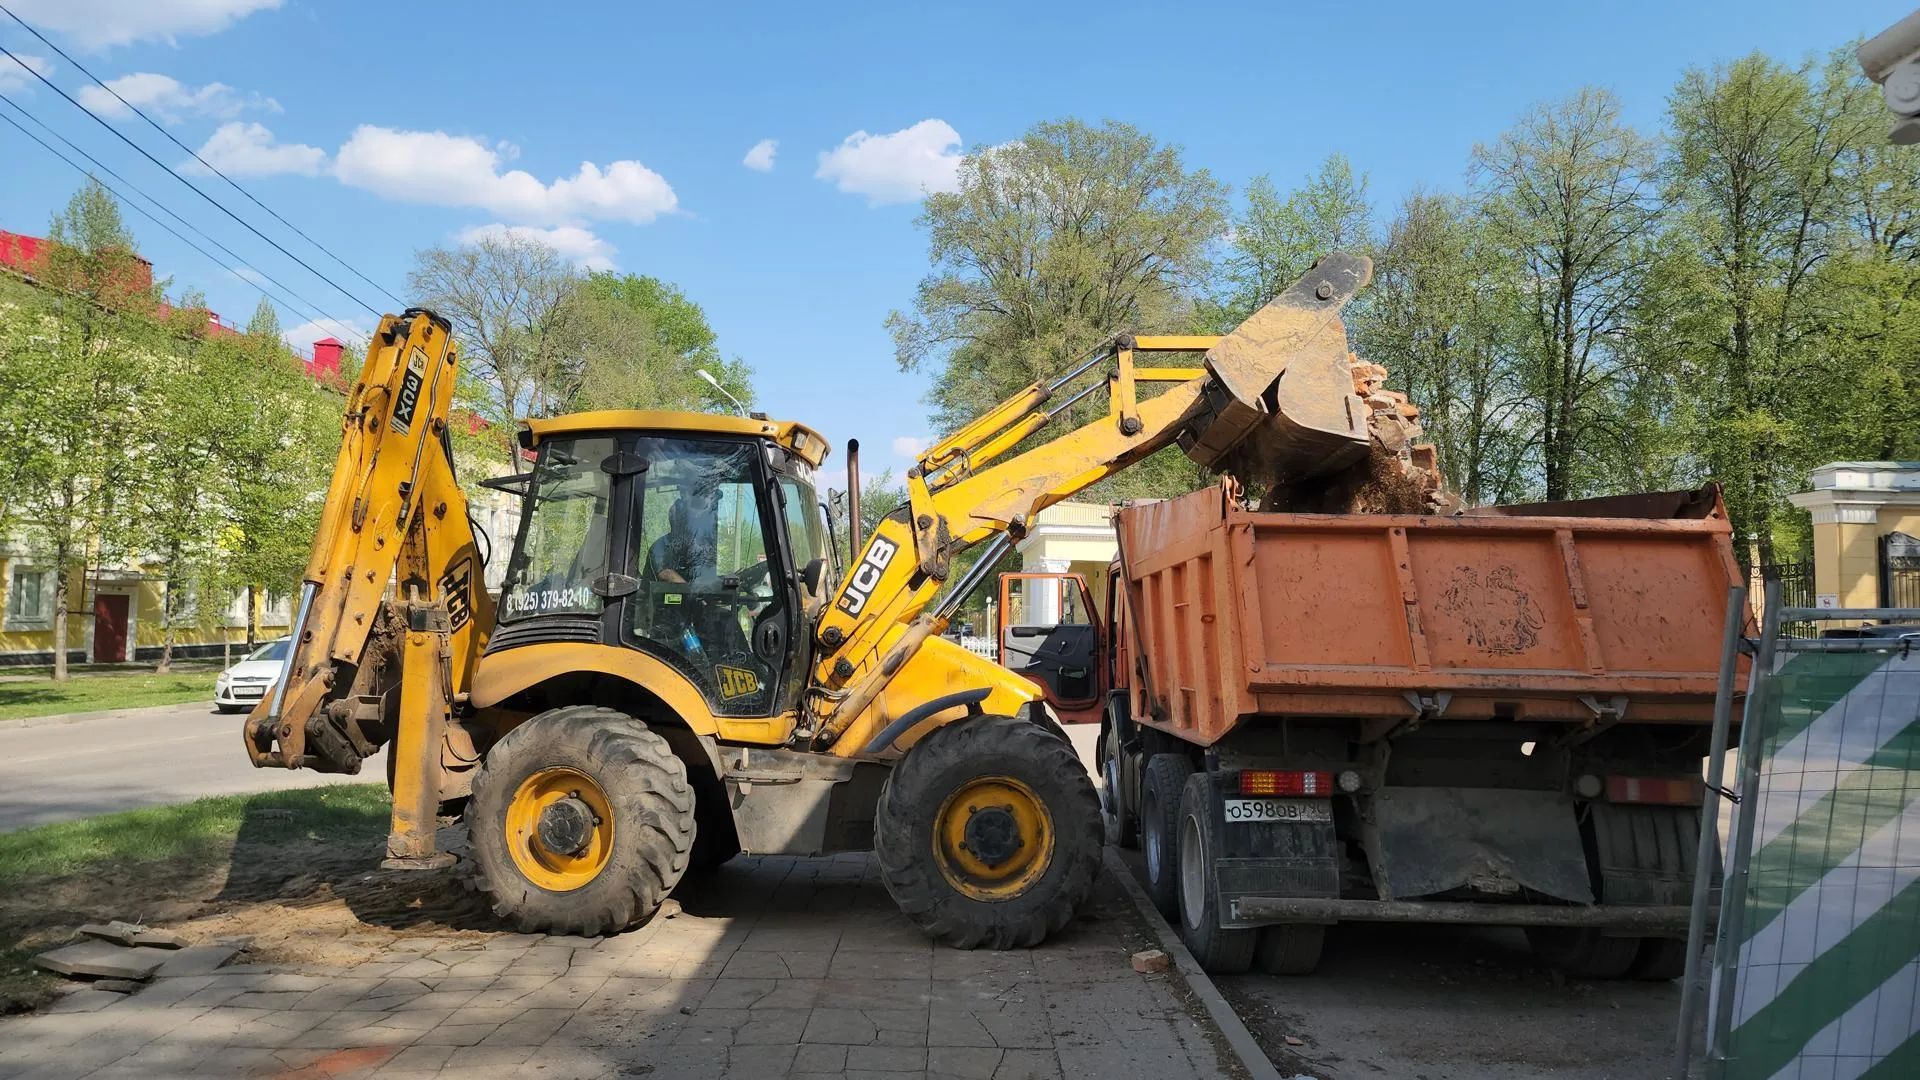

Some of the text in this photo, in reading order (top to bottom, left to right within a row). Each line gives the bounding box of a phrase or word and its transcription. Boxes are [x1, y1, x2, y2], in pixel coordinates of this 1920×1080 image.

[397, 375, 419, 421] 3CX
[443, 569, 469, 627] JCB
[506, 586, 589, 612] 8 (925) 379-82-10
[846, 539, 895, 613] JCB
[722, 668, 757, 697] JCB
